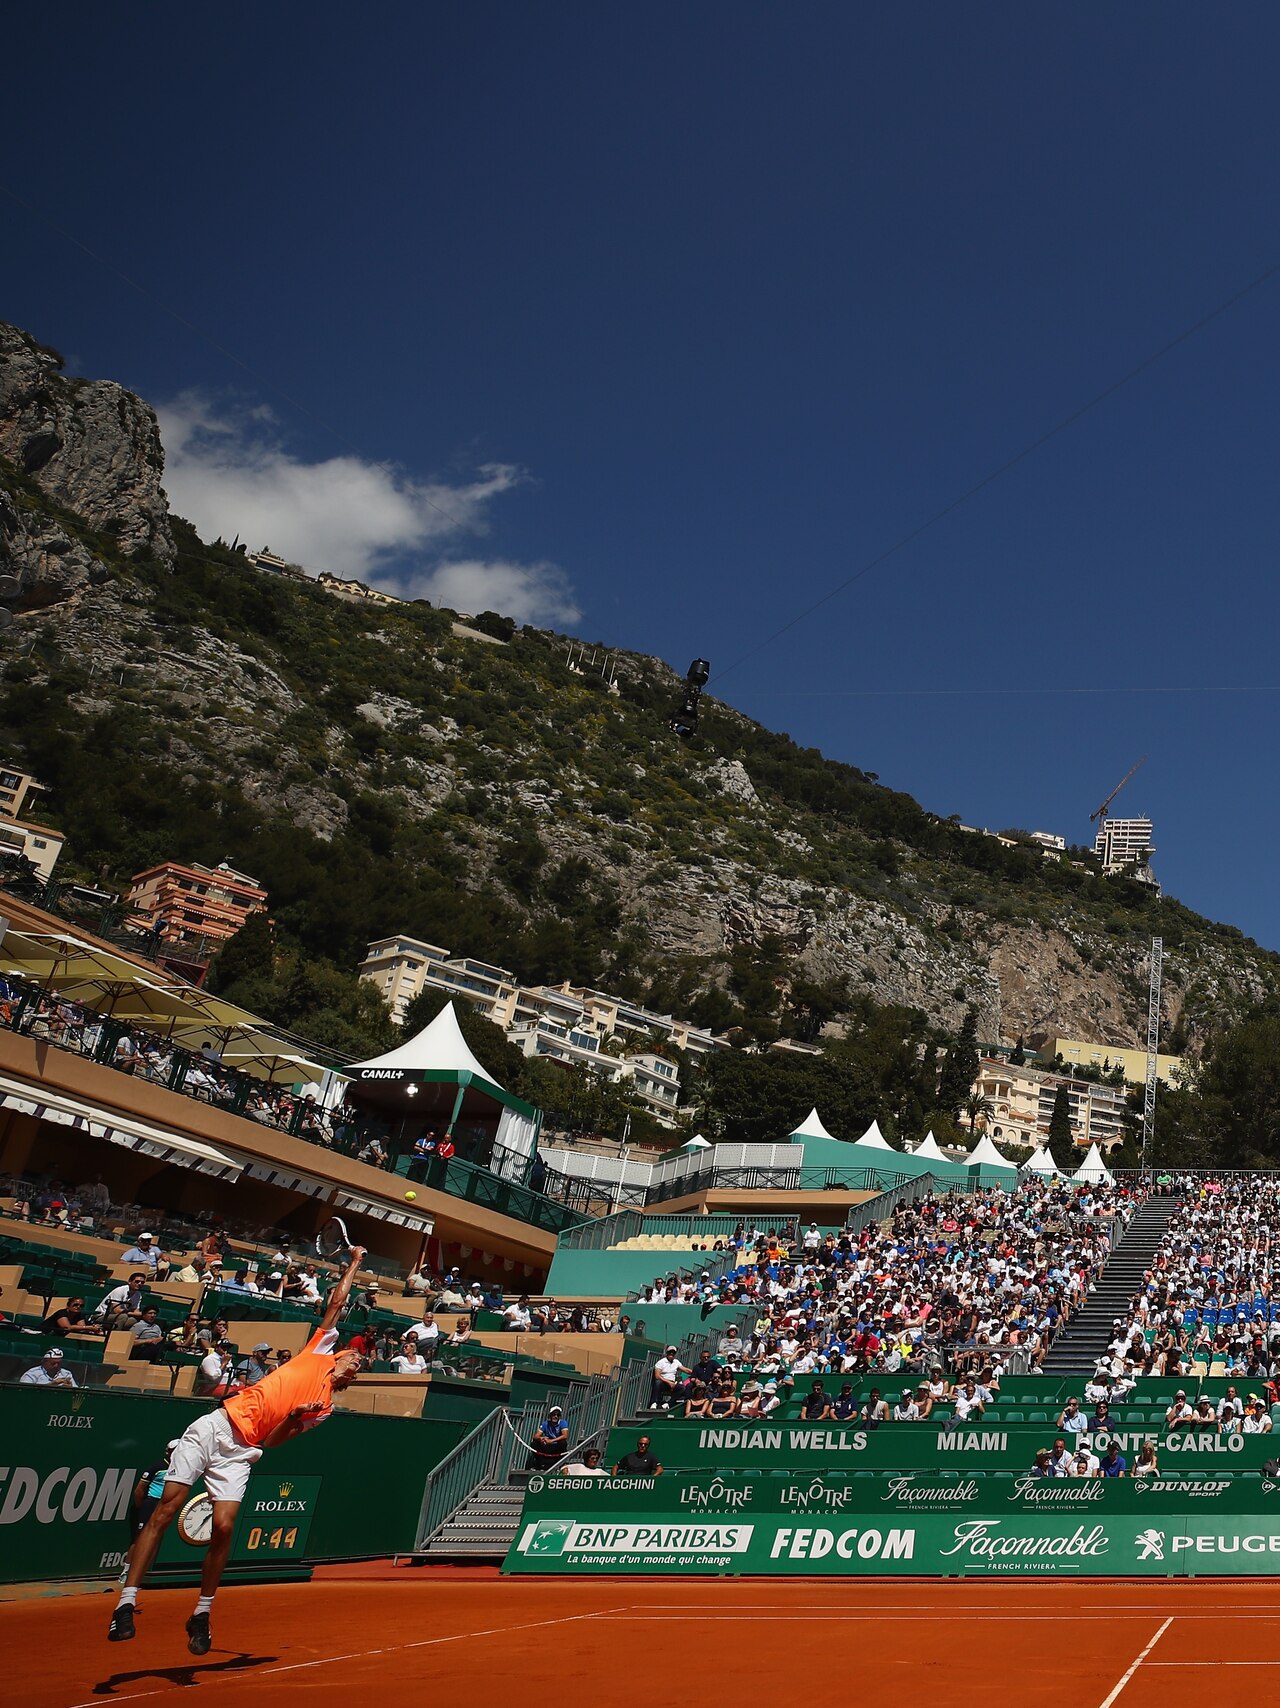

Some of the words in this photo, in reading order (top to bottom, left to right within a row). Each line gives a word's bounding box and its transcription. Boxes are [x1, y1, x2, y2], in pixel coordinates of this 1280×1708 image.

[361, 1069, 404, 1079] CANAL+
[47, 1414, 94, 1428] ROLEX
[699, 1429, 783, 1449] INDIAN
[789, 1431, 868, 1450] WELLS
[936, 1432, 1008, 1451] MIAMI
[548, 1478, 593, 1490] SERGIO
[597, 1478, 655, 1490] TACCHINI
[880, 1476, 979, 1503] Façonnable
[1007, 1476, 1105, 1503] Façonnable
[1150, 1481, 1231, 1491] DUNLOP
[0, 1467, 137, 1525] DCOM
[254, 1500, 307, 1512] ROLEX
[247, 1527, 298, 1550] 0:44
[574, 1528, 628, 1548] BNP
[632, 1528, 739, 1548] PARIBAS
[769, 1528, 915, 1559] FEDCOM
[939, 1520, 1109, 1561] Façonnable
[100, 1552, 129, 1568] FEDC
[567, 1554, 579, 1563] La
[581, 1555, 616, 1567] banque
[619, 1555, 640, 1564] d'un
[643, 1555, 676, 1564] monde
[678, 1555, 694, 1568] qui
[696, 1555, 731, 1566] change
